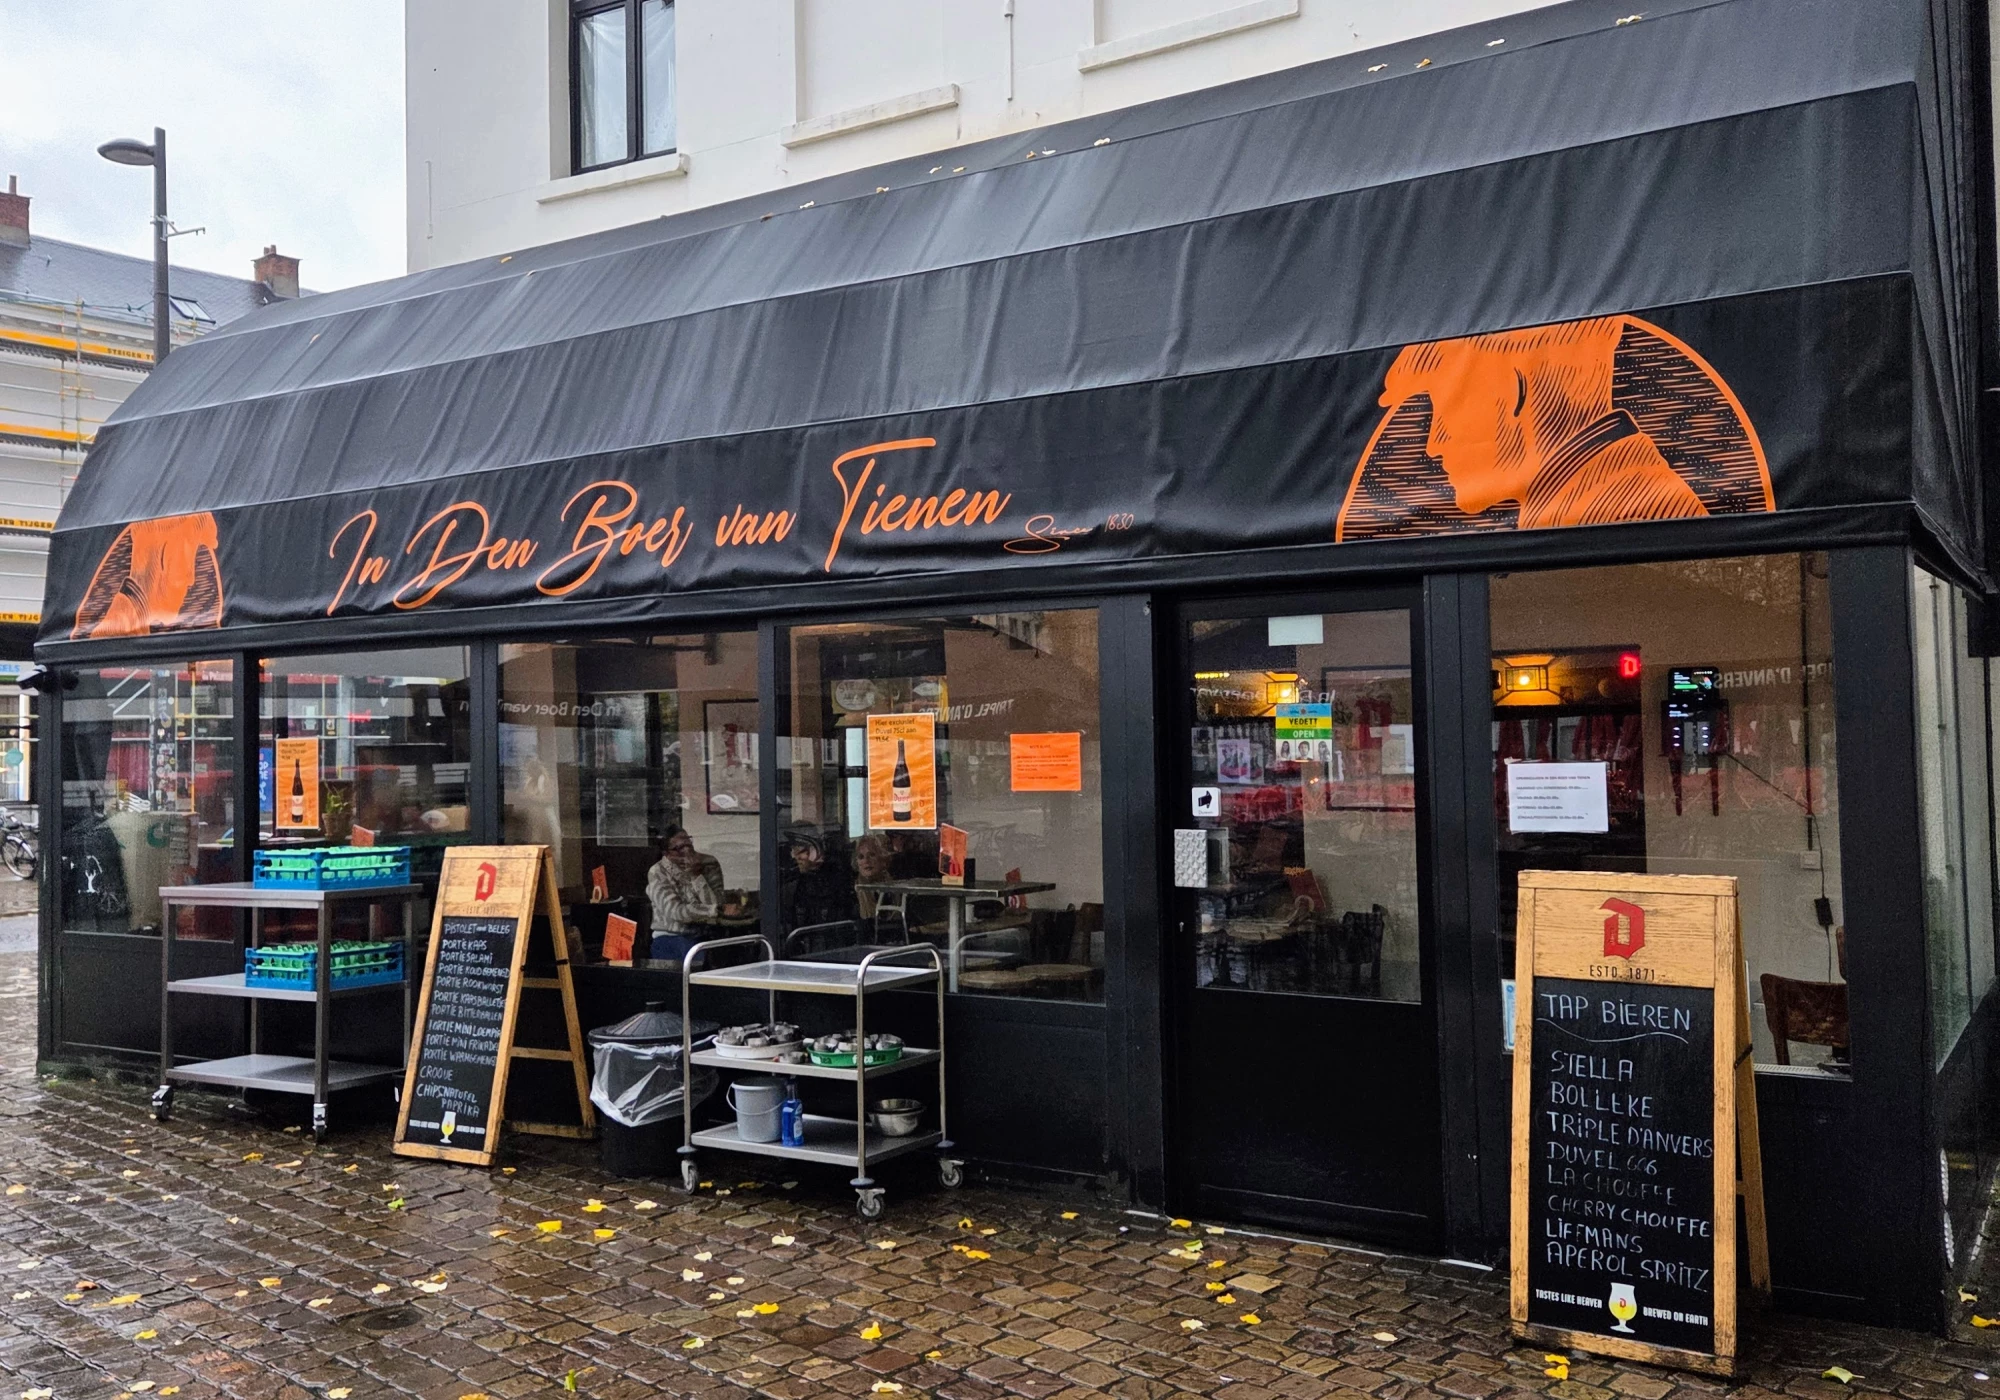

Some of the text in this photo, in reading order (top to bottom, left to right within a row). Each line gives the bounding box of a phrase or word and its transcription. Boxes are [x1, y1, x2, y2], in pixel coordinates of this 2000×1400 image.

[107, 347, 142, 359] STEIGER
[326, 437, 1011, 616] In Den Boer van Tienen
[1103, 513, 1136, 533] 1830
[1292, 729, 1315, 738] OPEN
[474, 862, 497, 902] D
[487, 923, 510, 934] BELEG
[1600, 897, 1646, 960] D
[438, 962, 464, 975] PORTIE
[465, 952, 493, 965] SALAMI
[436, 975, 461, 988] PORTIE
[1628, 967, 1655, 980] 1871
[433, 989, 459, 1003] PORTIE
[431, 1003, 456, 1016] PORTIE
[1540, 993, 1690, 1031] TAP BIEREN
[423, 1047, 448, 1061] PORTIE
[1551, 1050, 1633, 1082] STELLA
[441, 1098, 480, 1117] PAPRIKA
[1551, 1081, 1653, 1118] BOLLEKE
[1546, 1111, 1713, 1158] TRIPLE D'ANVERS
[1547, 1141, 1619, 1171] DUVEL
[1548, 1164, 1575, 1187] LA
[1546, 1241, 1709, 1293] APEROL SPRITZ
[1535, 1288, 1603, 1309] TASTES LIKE HEAVEN
[1643, 1306, 1709, 1327] BREWED ON EARTH
